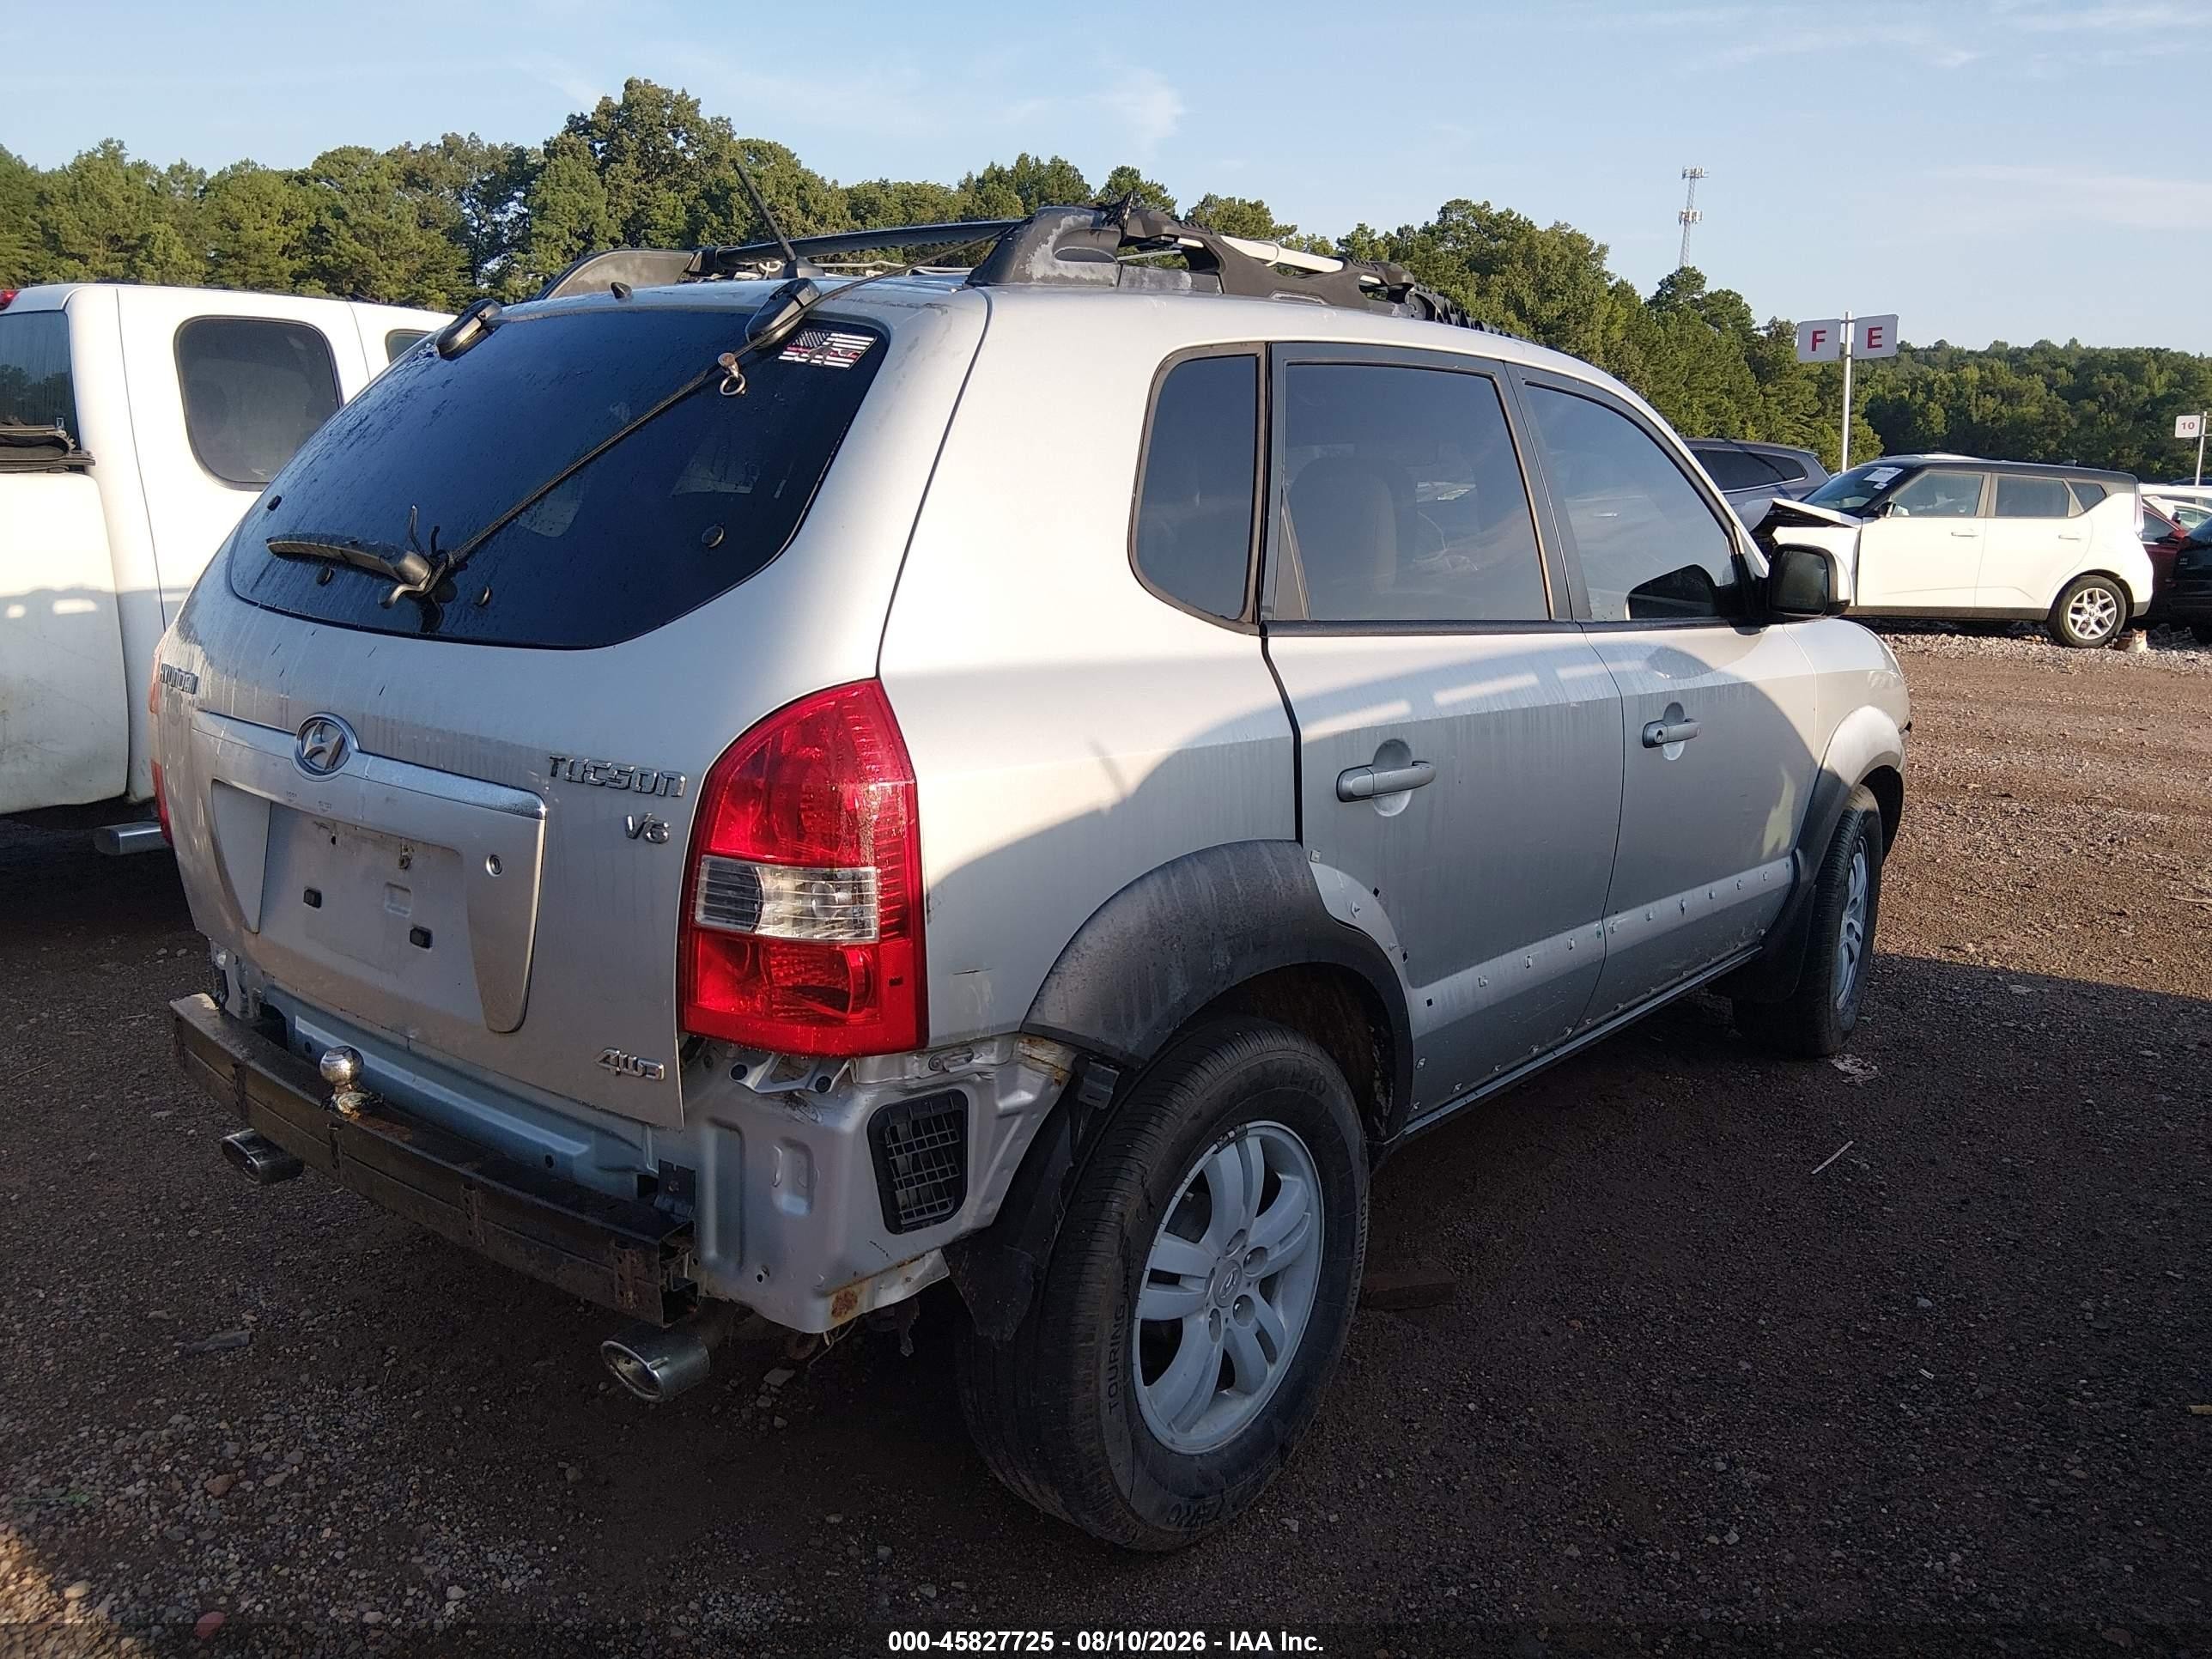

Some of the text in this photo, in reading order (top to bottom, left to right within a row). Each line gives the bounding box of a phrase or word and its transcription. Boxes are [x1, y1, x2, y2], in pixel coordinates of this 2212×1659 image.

[1811, 330, 1827, 352] F
[1867, 326, 1883, 349] E
[2181, 422, 2195, 430] 10
[160, 663, 198, 695] HYUNDAI
[549, 755, 687, 798] TUCSON
[624, 812, 670, 844] V6
[593, 1047, 665, 1081] 4WD
[1107, 1304, 1126, 1416] TOURING
